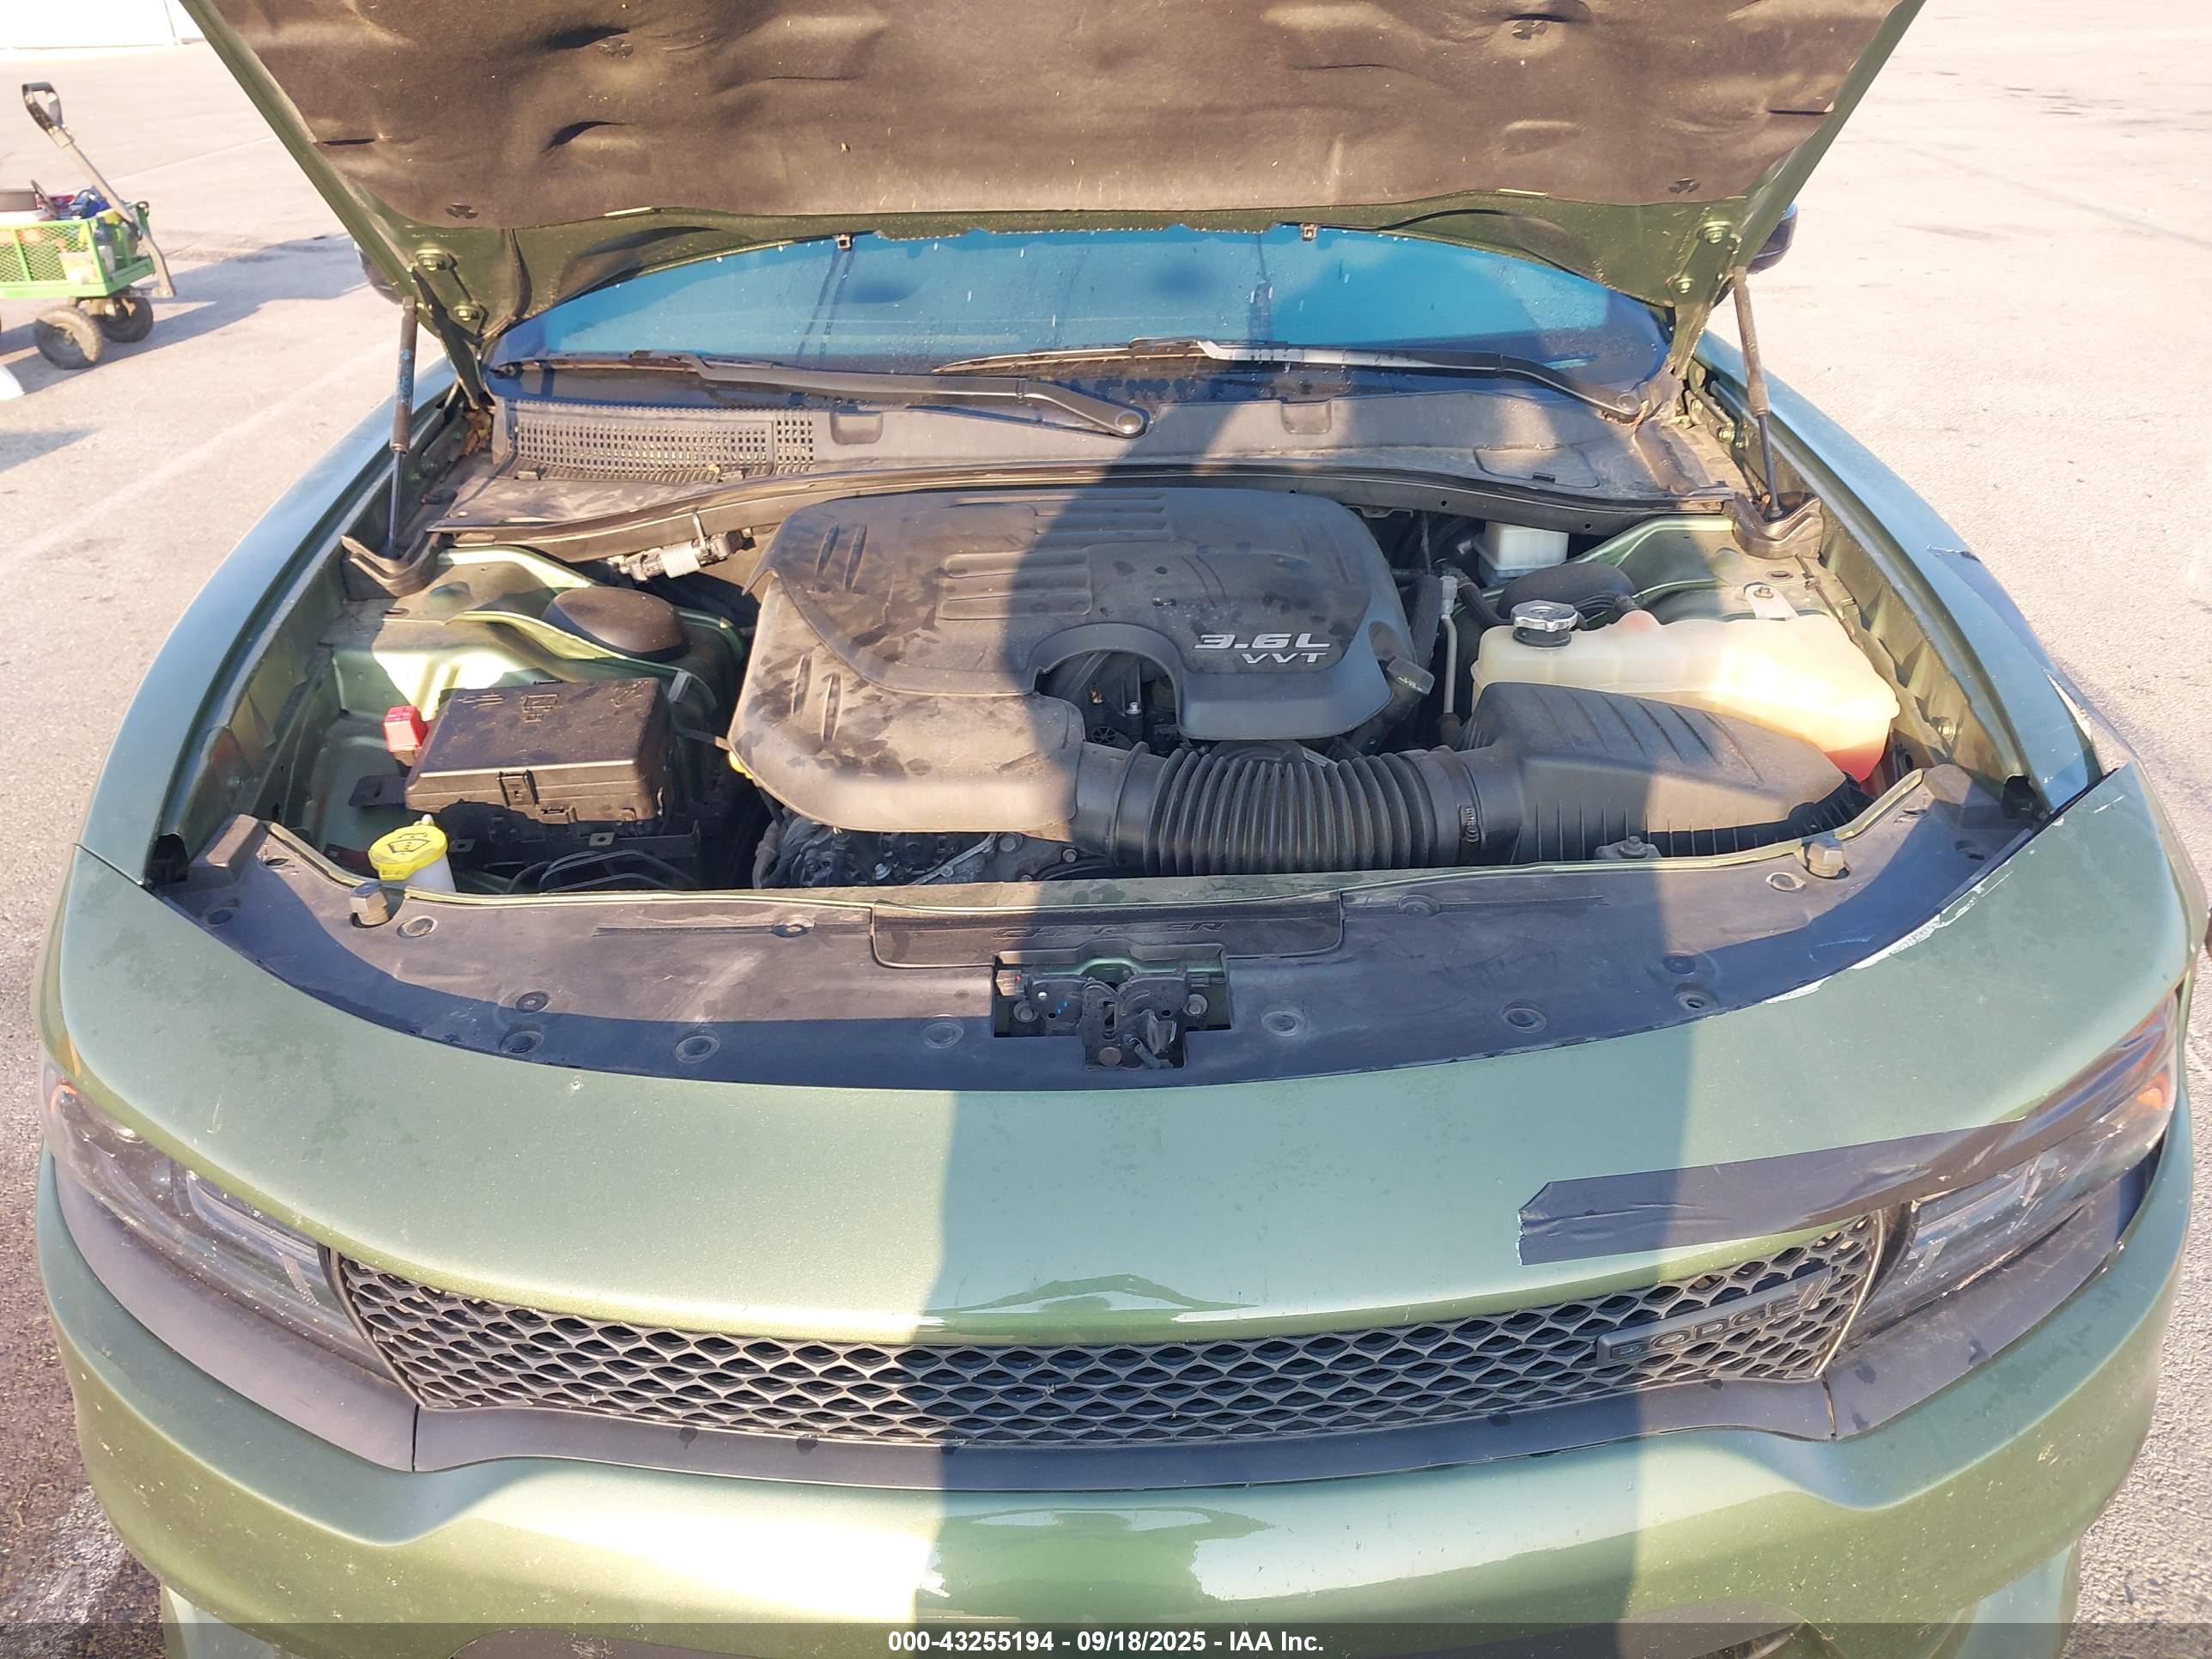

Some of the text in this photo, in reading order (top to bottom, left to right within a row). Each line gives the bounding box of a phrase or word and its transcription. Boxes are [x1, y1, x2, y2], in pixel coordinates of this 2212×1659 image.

[1194, 632, 1331, 650] 3.6L
[1241, 652, 1328, 665] VVT
[1609, 1294, 1802, 1360] DODGE
